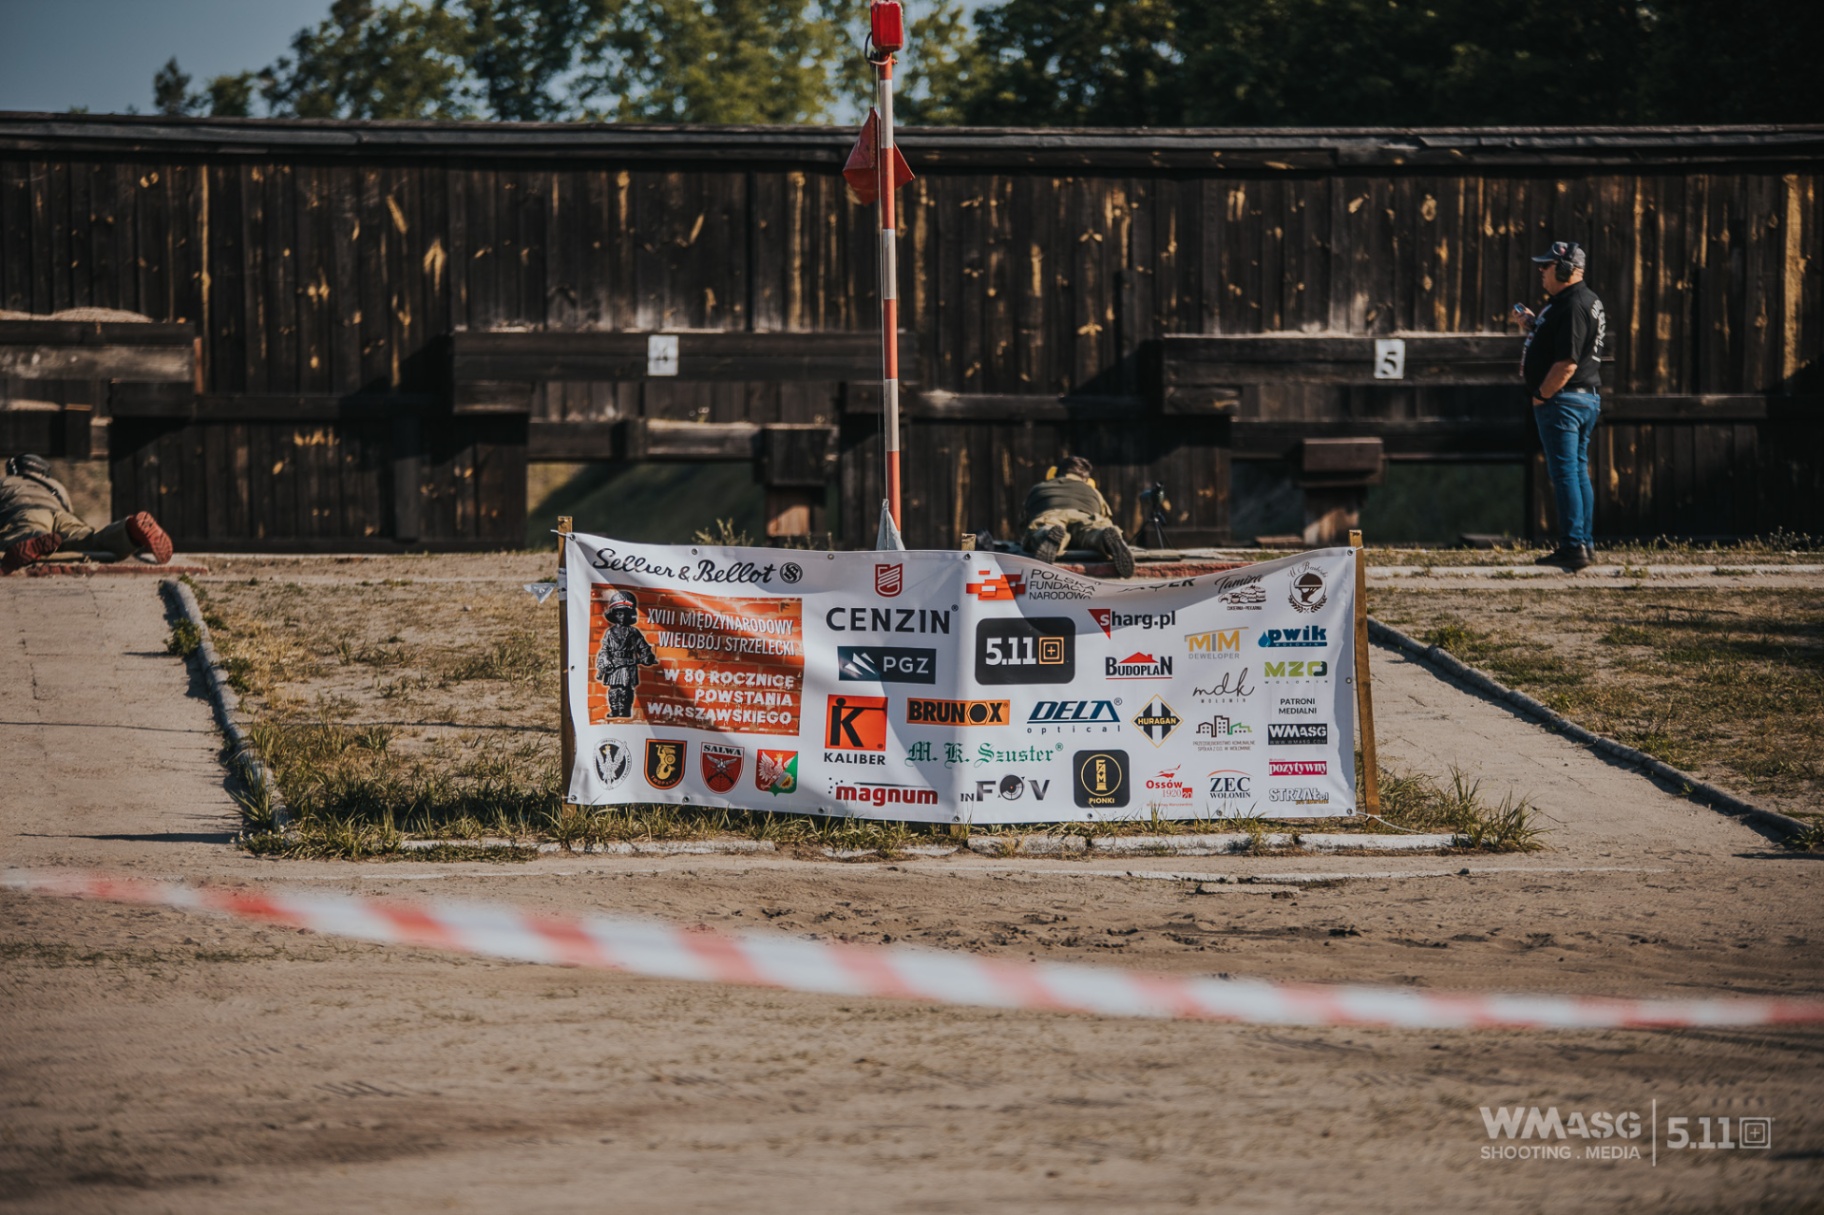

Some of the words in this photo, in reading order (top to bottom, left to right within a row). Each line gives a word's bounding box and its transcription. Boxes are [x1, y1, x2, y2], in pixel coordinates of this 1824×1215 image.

[1381, 351, 1397, 376] 5
[592, 547, 675, 578] Sellier
[678, 566, 690, 582] &
[693, 559, 776, 583] Bellot
[1029, 581, 1093, 597] FUNDACJA
[1031, 569, 1096, 592] POLSKA
[646, 608, 675, 625] XVIII
[680, 610, 793, 635] MIĘDZYNARODOWY
[826, 606, 950, 634] CENZIN
[1099, 611, 1176, 630] sharg.pl
[1268, 625, 1327, 642] pwik
[658, 631, 720, 651] WIELOBÓJ
[724, 636, 796, 656] STRZELECKI
[985, 636, 1037, 666] 5.11
[883, 656, 929, 674] PGZ
[1188, 652, 1240, 660] DEWELOPER
[1264, 661, 1328, 677] MZO
[664, 668, 680, 682] W
[684, 668, 706, 684] 80
[709, 671, 795, 689] ROCZNICĘ
[1192, 667, 1255, 697] mdk
[694, 689, 793, 706] POWSTANIA
[647, 702, 793, 724] WARSZAWSKIEGO
[908, 700, 1003, 724] BRUNOX
[1028, 700, 1121, 722] DELTA
[1278, 707, 1317, 715] MEDIALNI
[1137, 717, 1177, 725] HURAGAN
[1268, 725, 1327, 738] WMASG
[703, 744, 742, 756] SALWA
[824, 752, 886, 765] KALIBER
[974, 742, 1054, 768] Szuster
[1269, 763, 1327, 775] pozytywny
[1146, 779, 1183, 789] Ossów
[1210, 777, 1250, 792] ZEC
[835, 785, 938, 807] magnum
[1162, 789, 1181, 798] 1920
